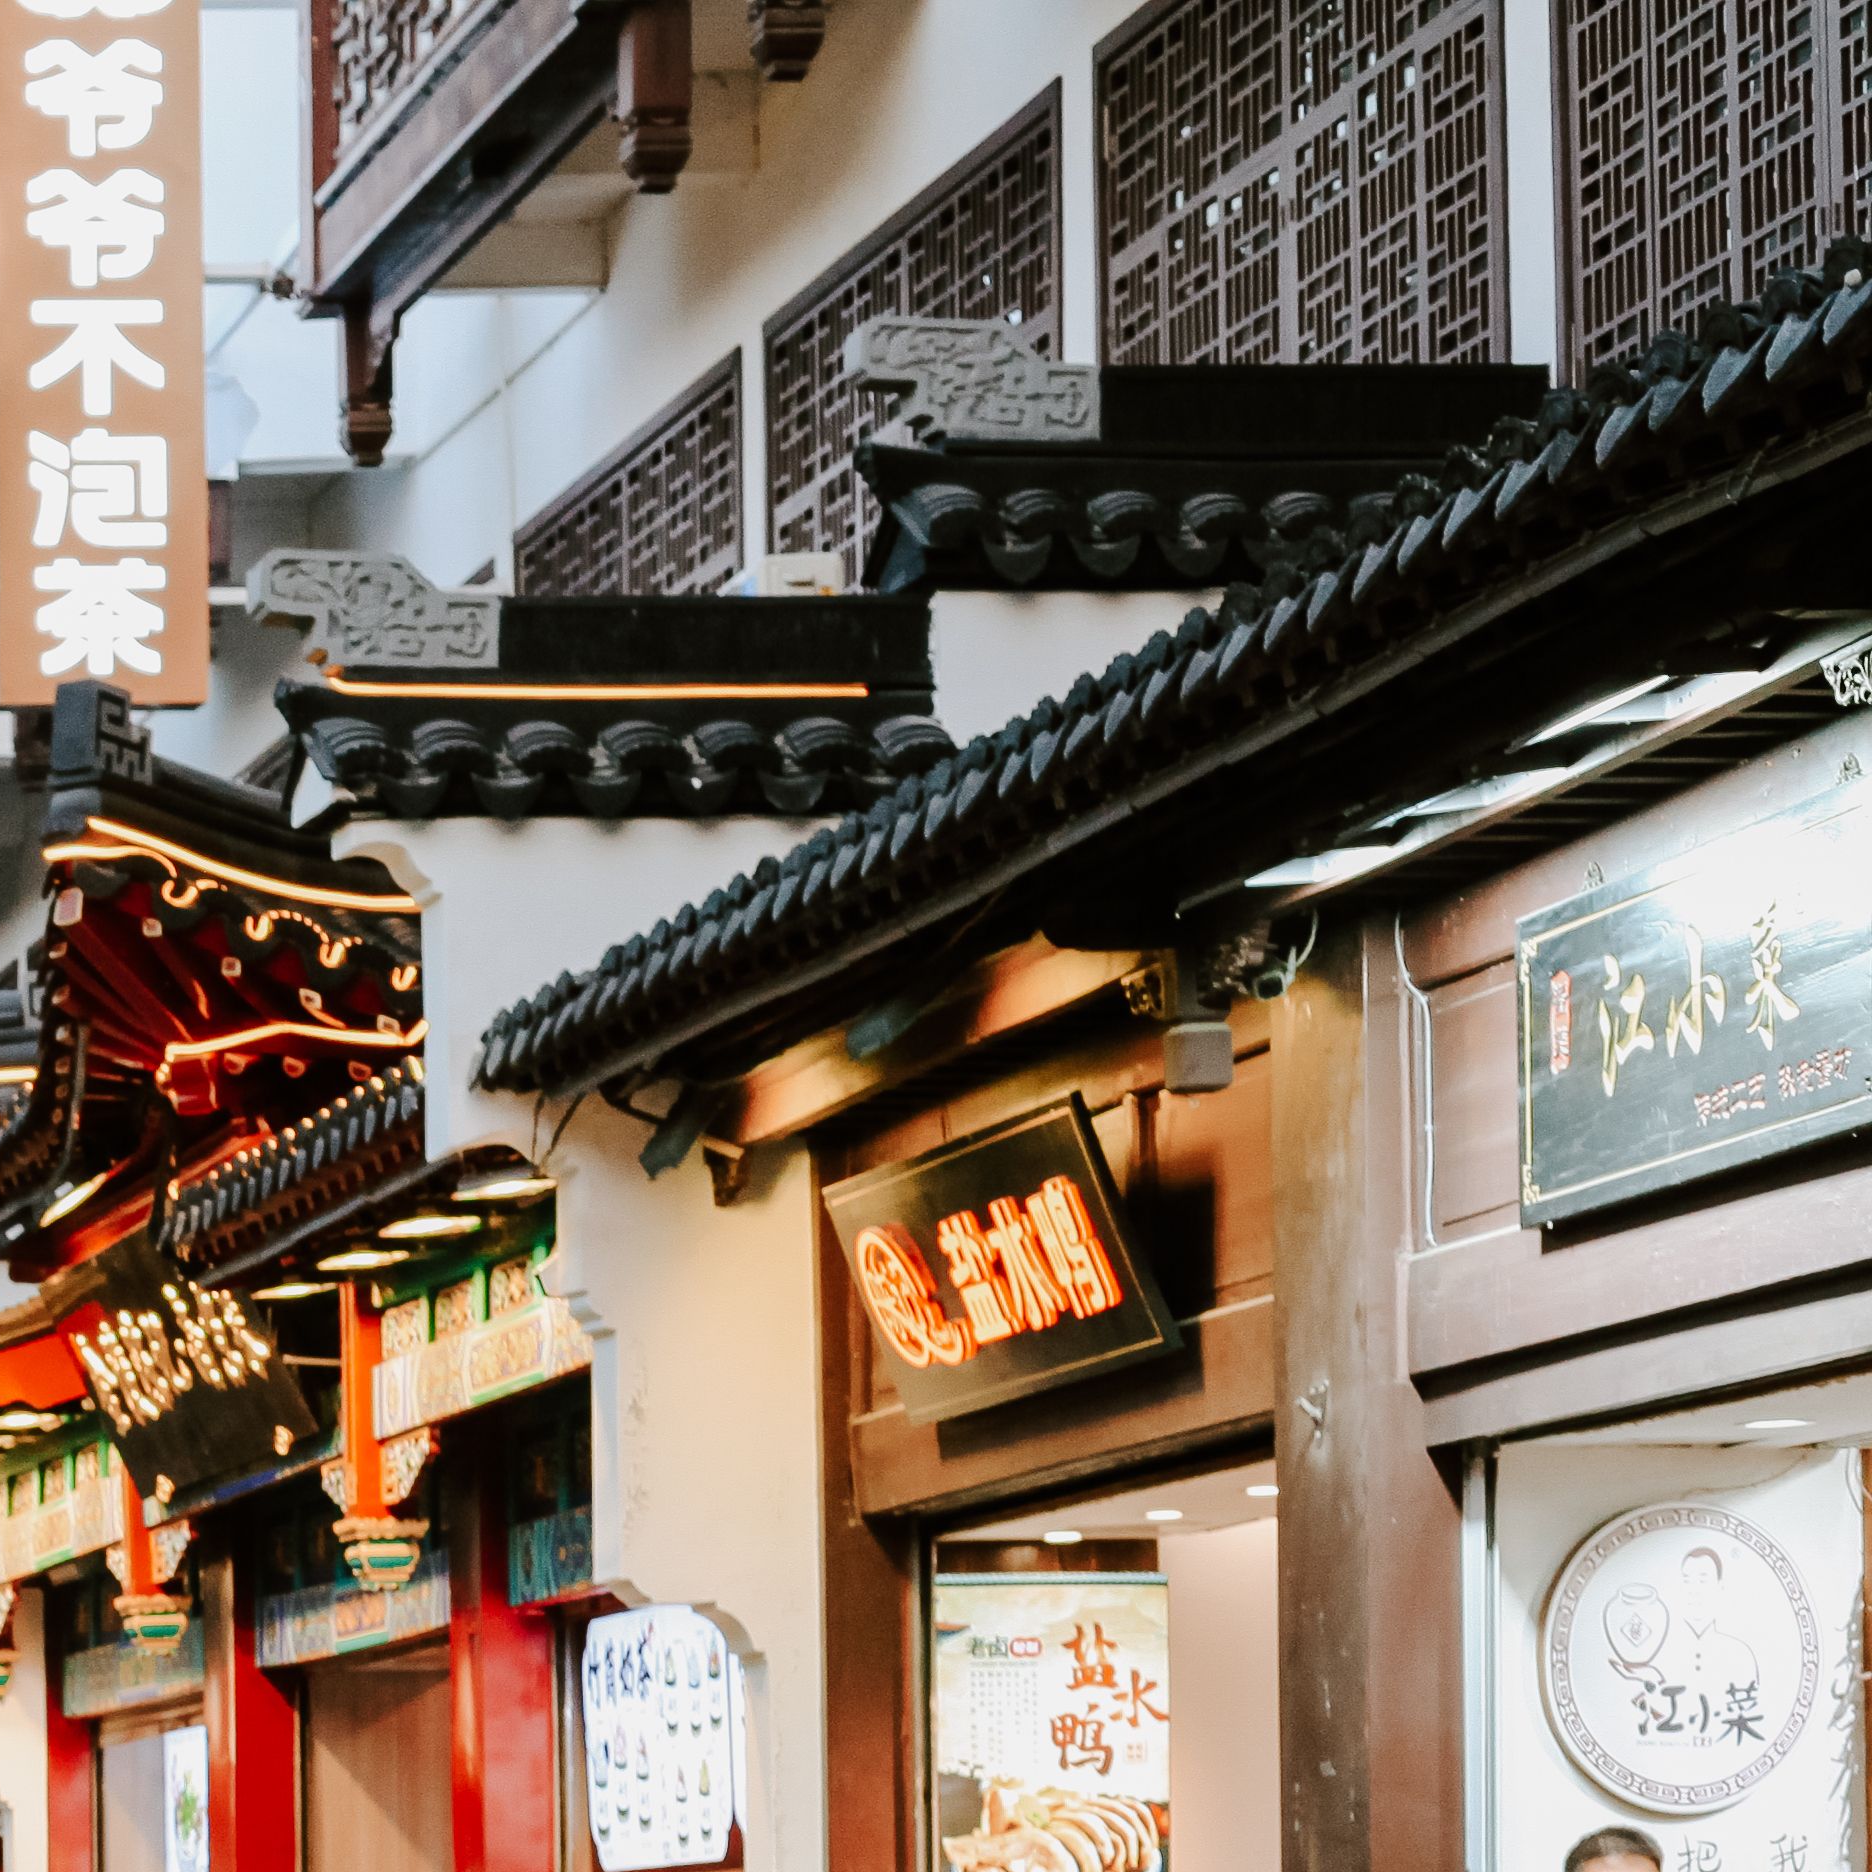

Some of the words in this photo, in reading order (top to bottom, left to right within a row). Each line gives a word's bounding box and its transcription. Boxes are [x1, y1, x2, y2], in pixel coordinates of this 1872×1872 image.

[24, 37, 169, 677] 爷爷不泡茶
[937, 1174, 1123, 1345] 盐水鸭
[1050, 1621, 1170, 1777] 盐水鸭
[1631, 1680, 1767, 1747] 江小菜
